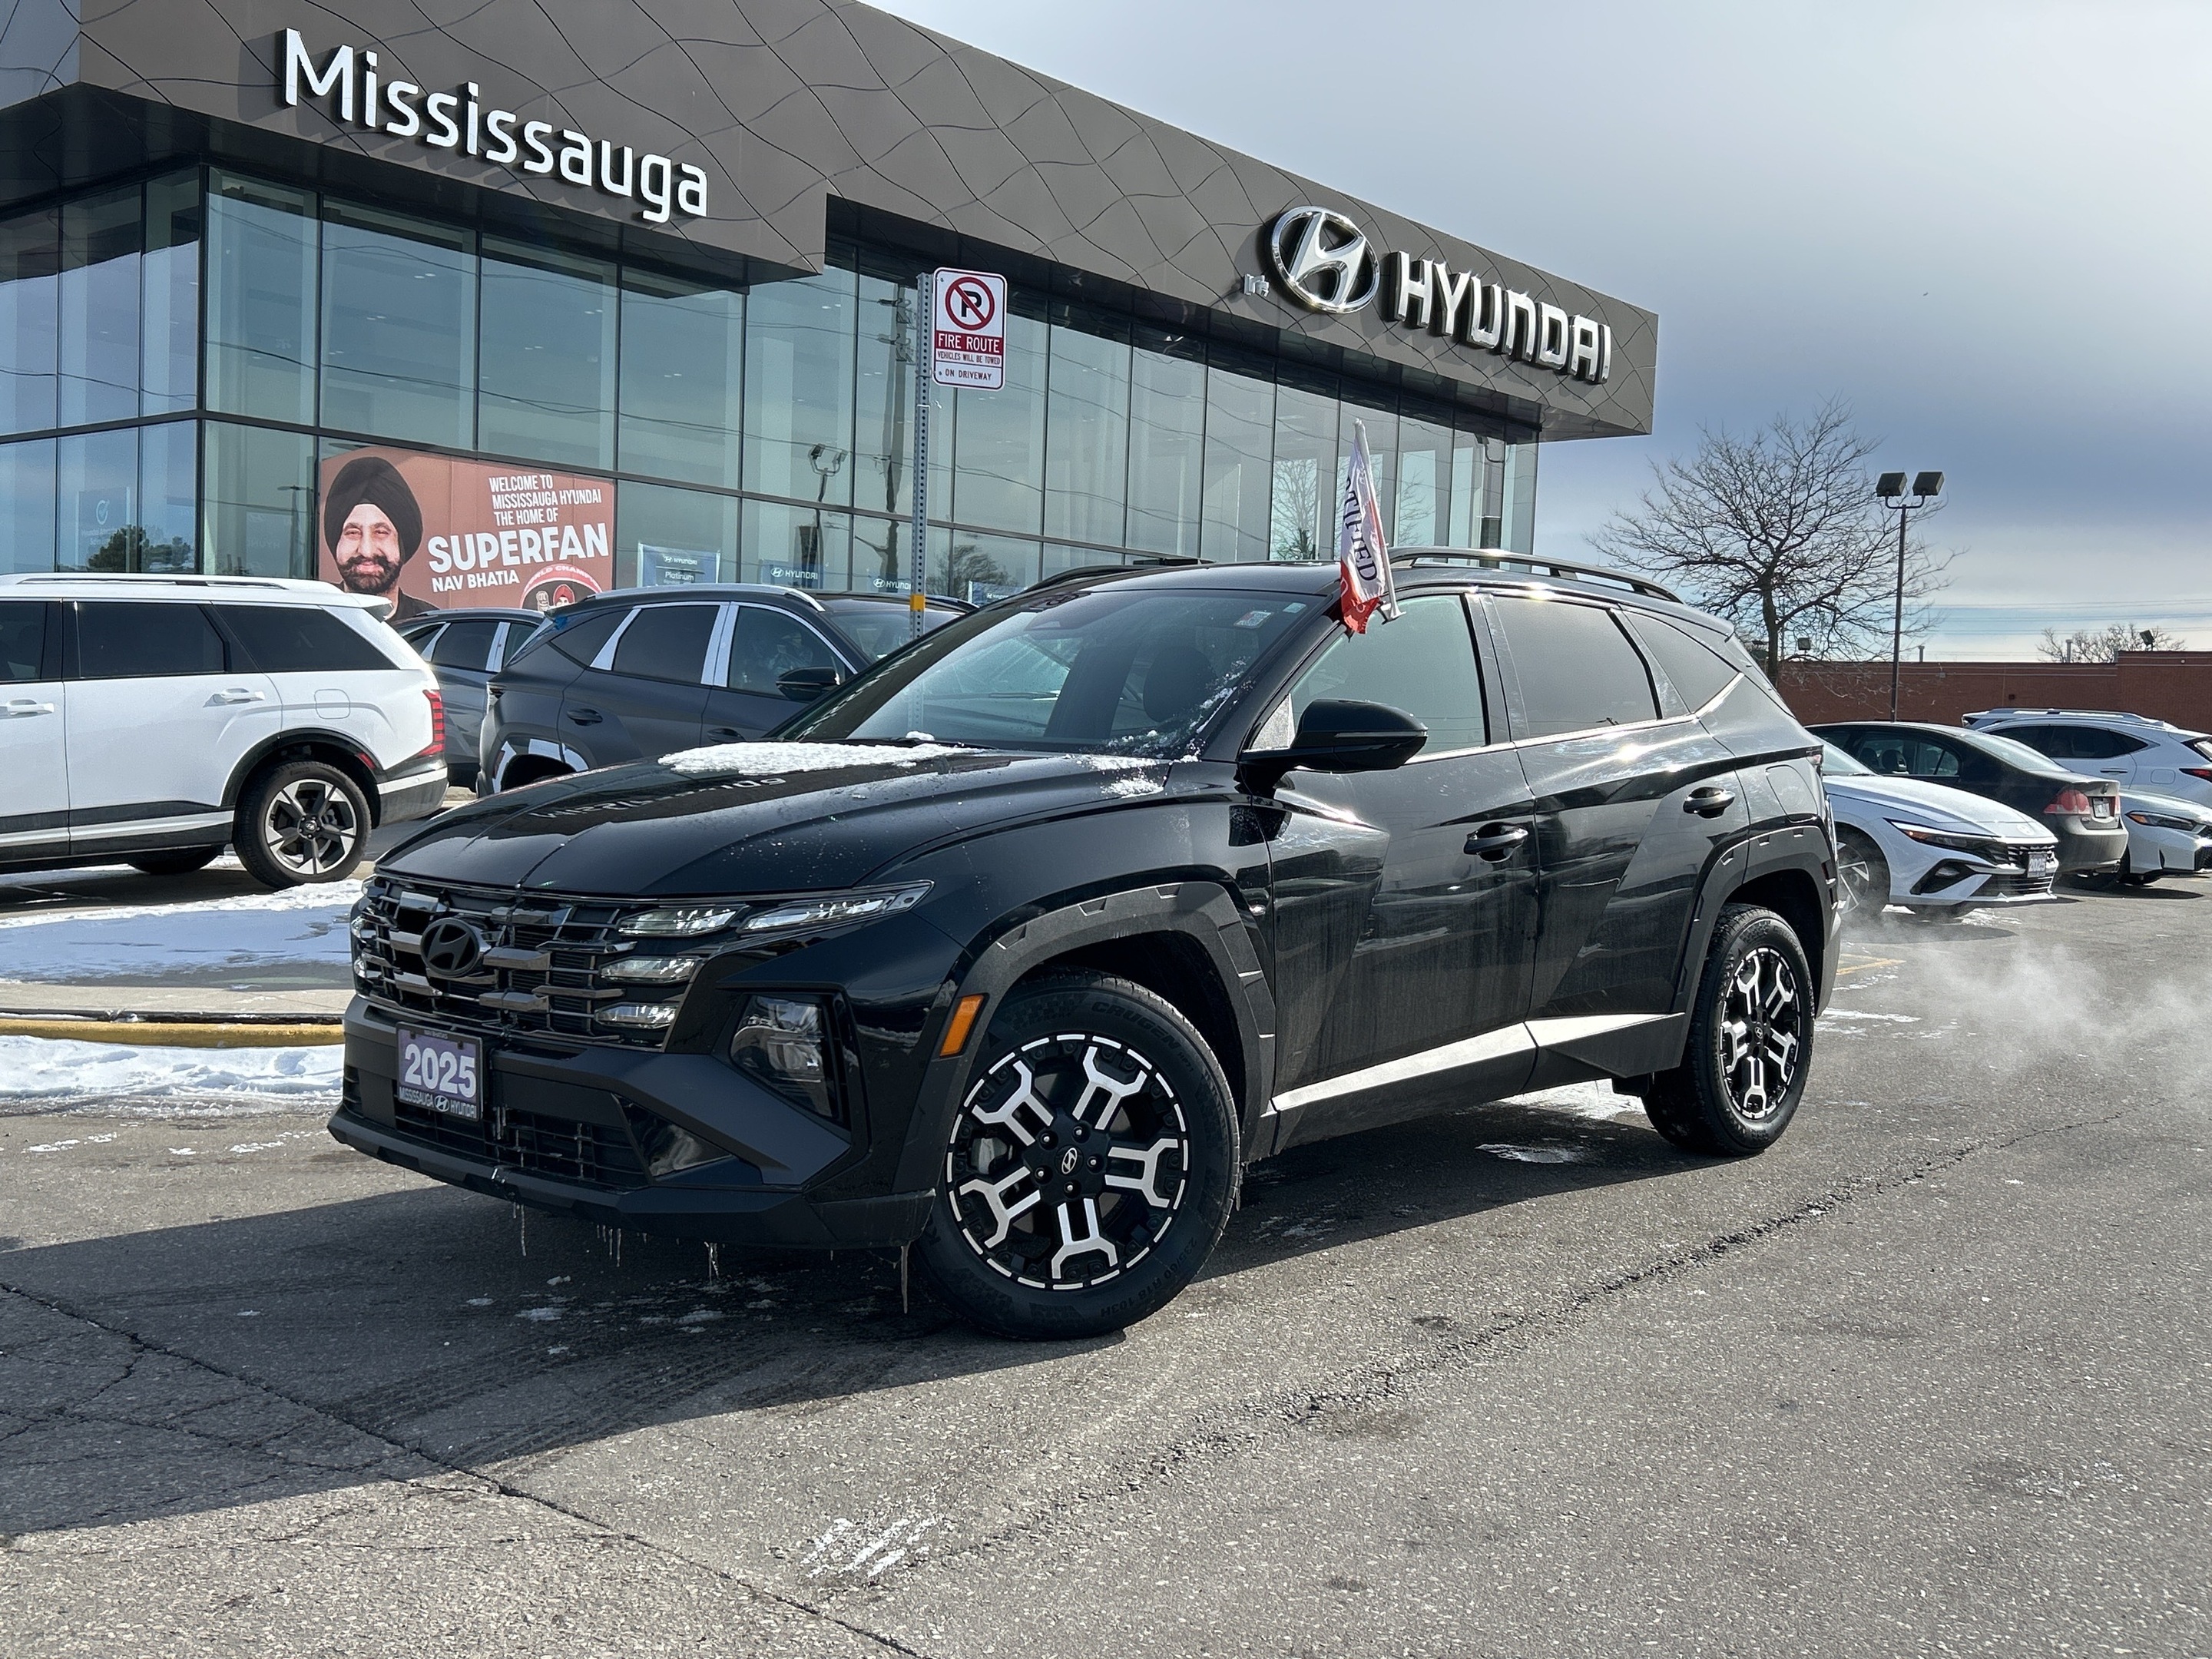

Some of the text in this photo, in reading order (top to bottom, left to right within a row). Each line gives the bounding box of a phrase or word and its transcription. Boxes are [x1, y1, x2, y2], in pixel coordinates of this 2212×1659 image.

[285, 27, 708, 224] Mississauga
[1394, 250, 1611, 384] HYUNDAI
[938, 333, 1000, 353] FIRE ROUTE
[937, 351, 1001, 365] VEHICLES WILL BE TOWED
[959, 369, 992, 381] DRIVEWAY
[488, 474, 554, 492] WELCOME TO
[492, 488, 602, 510] MISSISSAUGA HYUNDAI
[493, 507, 559, 527] THE HOME OF
[427, 522, 609, 574] SUPERFAN
[432, 569, 521, 593] NAV BHATIA
[664, 571, 694, 581] Platinum
[784, 570, 818, 580] HYUNDAI
[2028, 858, 2045, 873] 2025
[1091, 1001, 1183, 1050] CRUGEN
[404, 1043, 477, 1098] 2025
[399, 1085, 477, 1119] MISSISSAUGA HYUNDAI
[1162, 1237, 1197, 1279] 235/60
[1099, 1296, 1135, 1318] 103H
